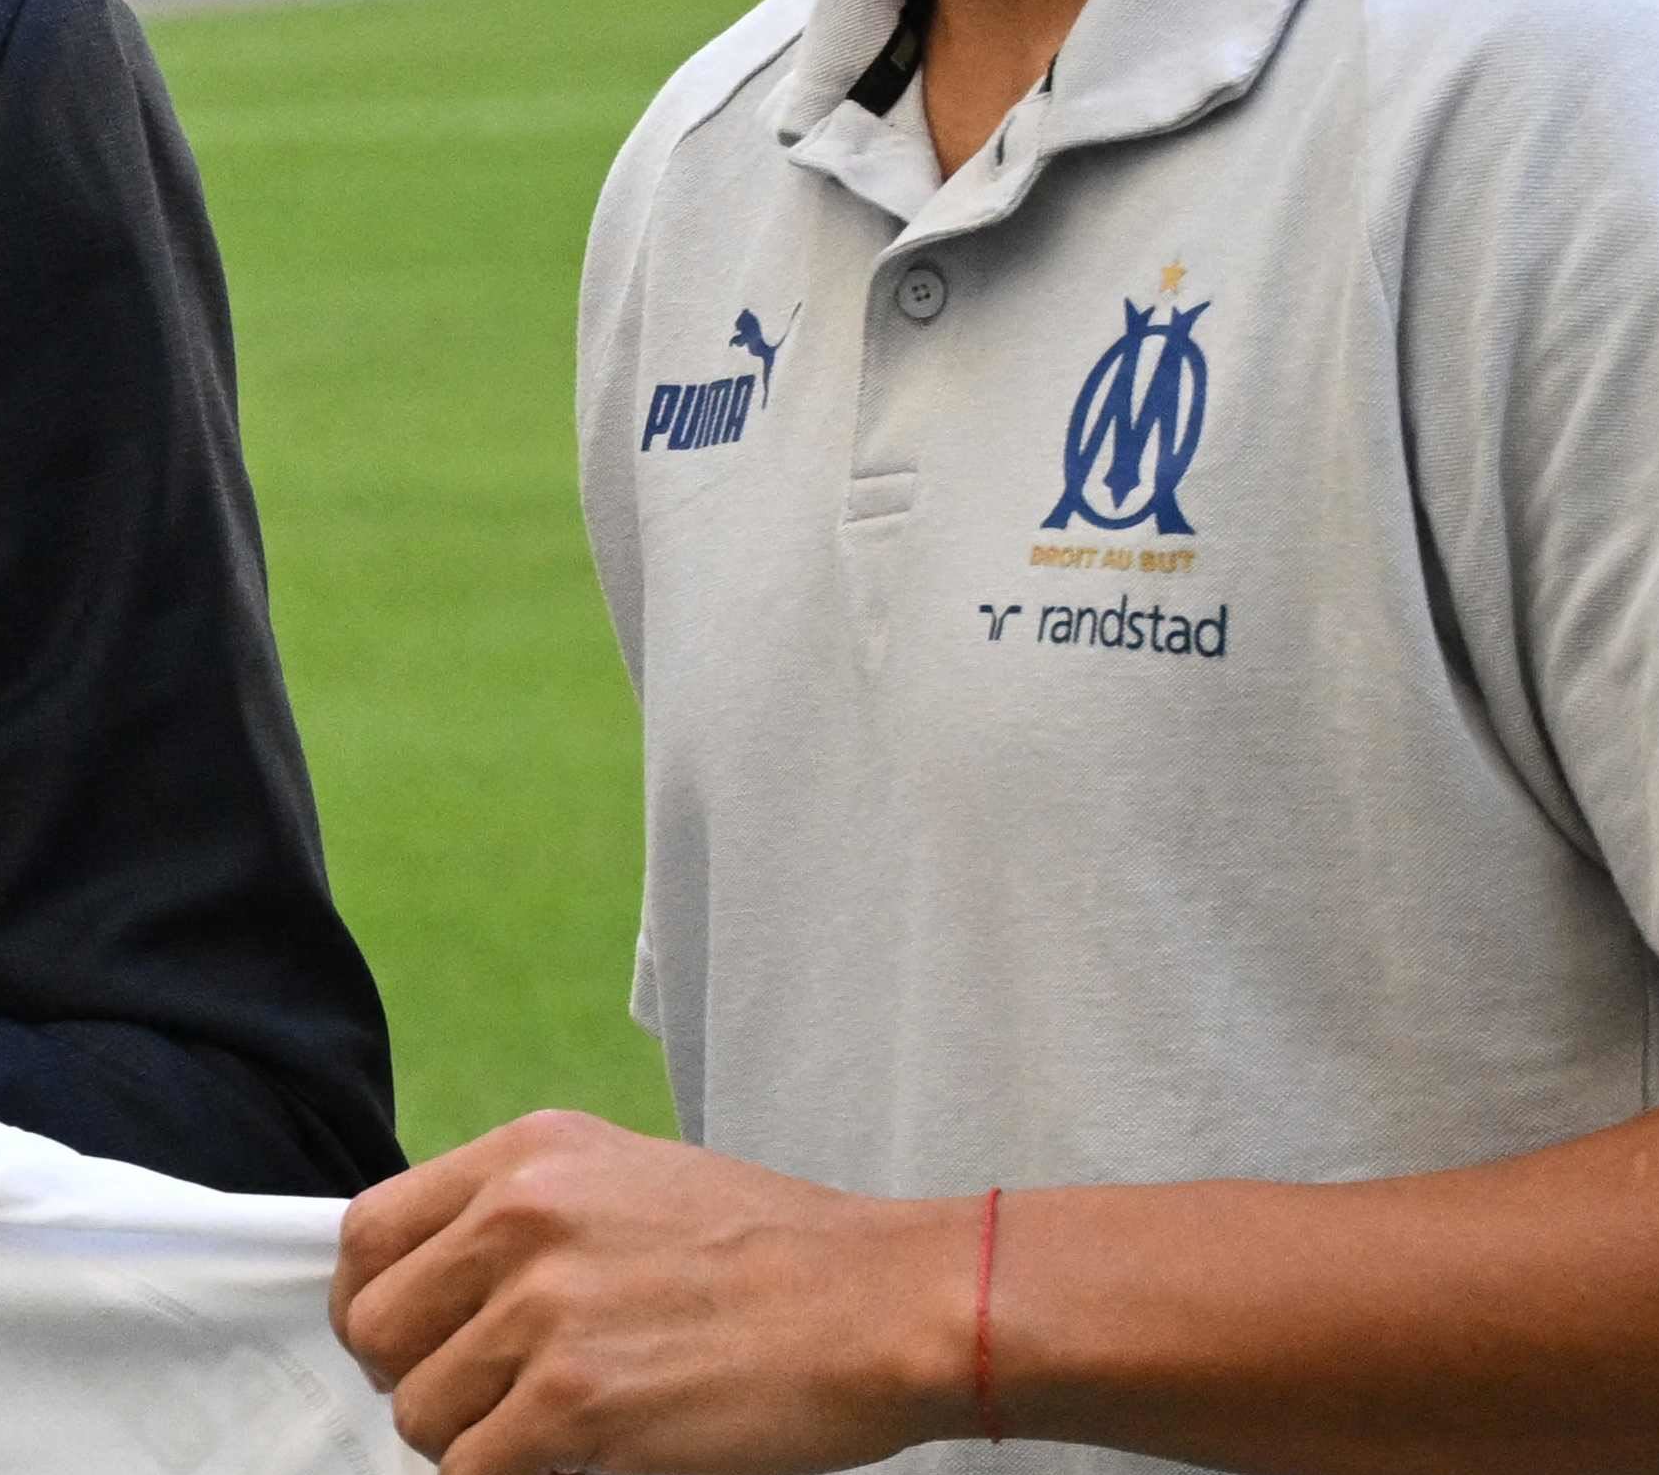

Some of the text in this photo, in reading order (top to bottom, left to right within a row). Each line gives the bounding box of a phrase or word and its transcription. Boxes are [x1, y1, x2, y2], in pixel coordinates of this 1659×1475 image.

[640, 374, 757, 453] PUMA
[1139, 549, 1195, 573] BUT
[1037, 593, 1229, 658] randstad
